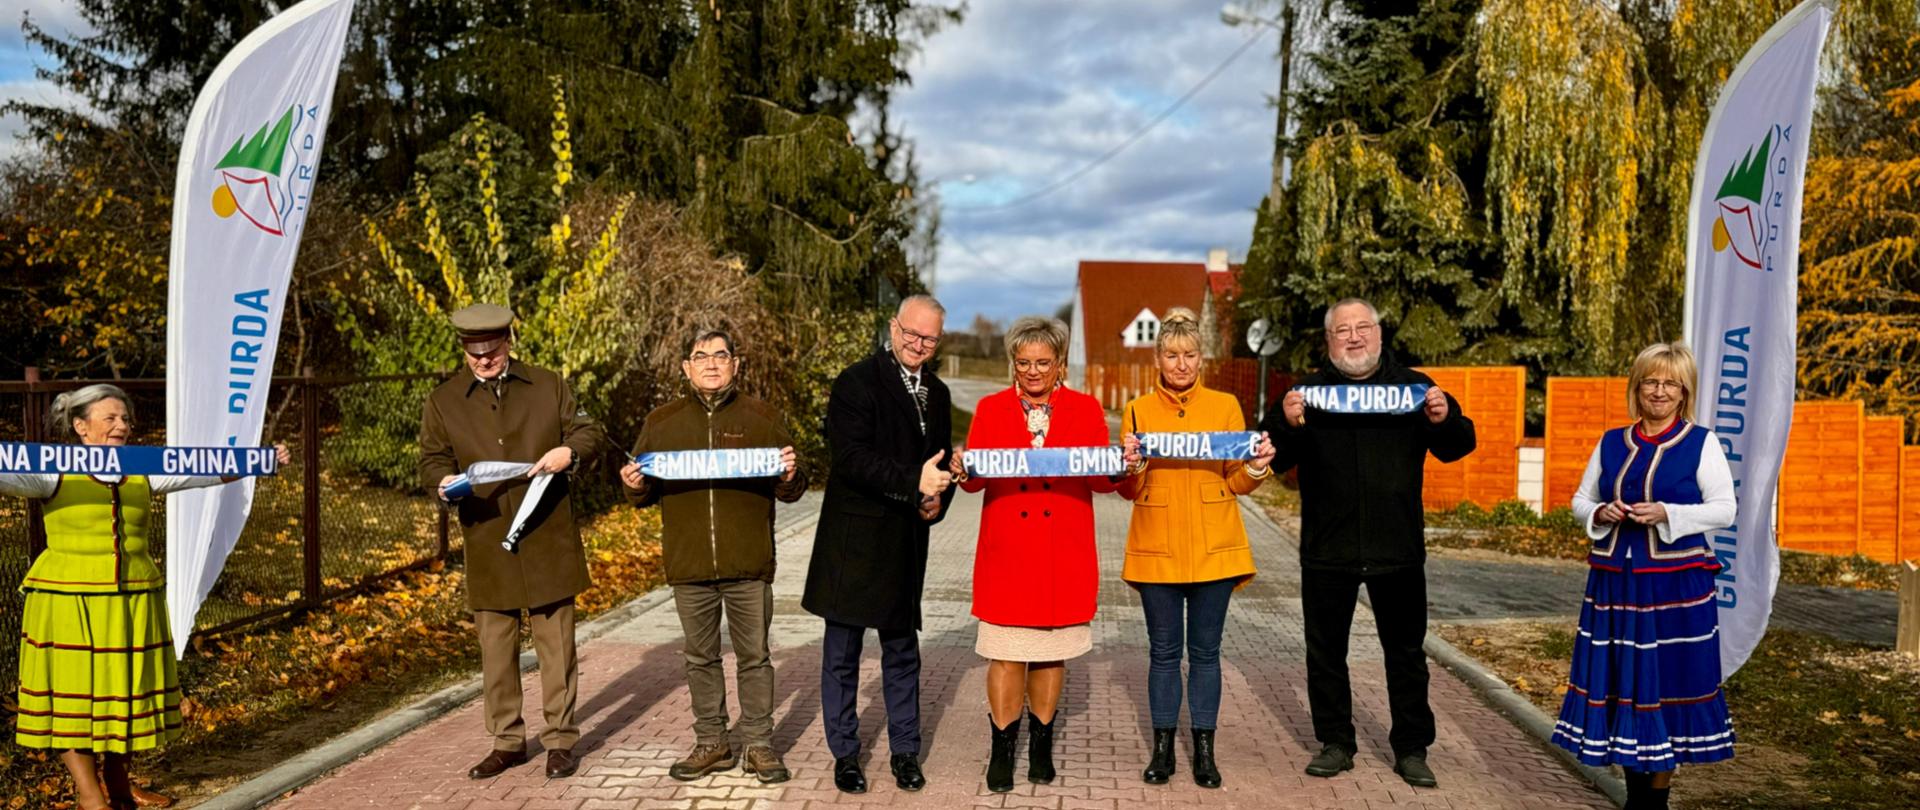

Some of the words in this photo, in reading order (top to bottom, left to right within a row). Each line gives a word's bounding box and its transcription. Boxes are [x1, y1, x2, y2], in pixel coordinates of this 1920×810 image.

[1766, 124, 1793, 271] PURDA
[1346, 386, 1415, 410] PURDA
[1716, 326, 1751, 462] PURDA
[1146, 433, 1213, 458] PURDA
[40, 446, 121, 473] PURDA
[163, 449, 239, 474] GMINA
[246, 449, 278, 474] PU
[654, 452, 720, 477] GMINA
[962, 450, 1030, 475] PURDA
[1713, 479, 1741, 609] GMI
